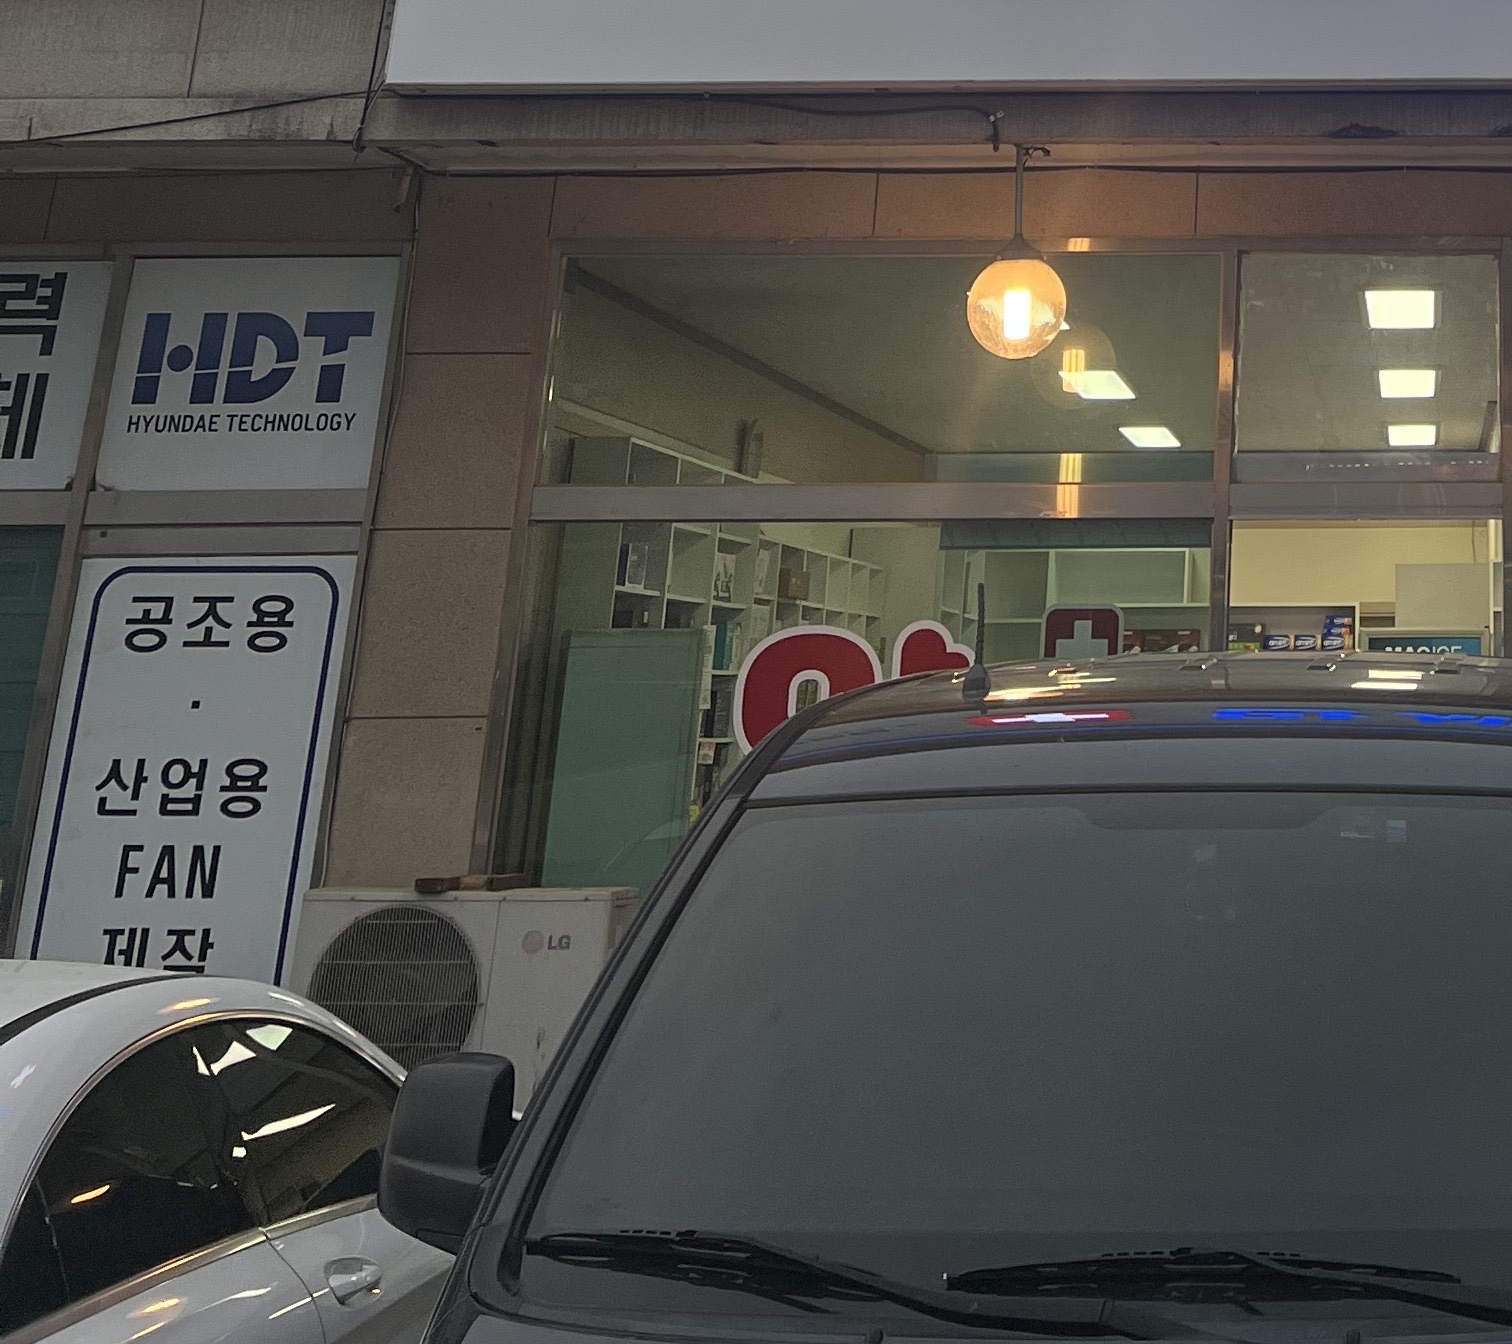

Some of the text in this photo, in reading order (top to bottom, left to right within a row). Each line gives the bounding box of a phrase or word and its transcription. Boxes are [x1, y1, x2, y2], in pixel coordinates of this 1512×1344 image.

[131, 311, 376, 405] HDT
[127, 412, 357, 434] HYUNDAE TECHNOLOGY
[124, 594, 296, 654] 공조용
[95, 758, 268, 819] 산업용
[114, 844, 222, 900] FAN
[547, 934, 572, 951] LG
